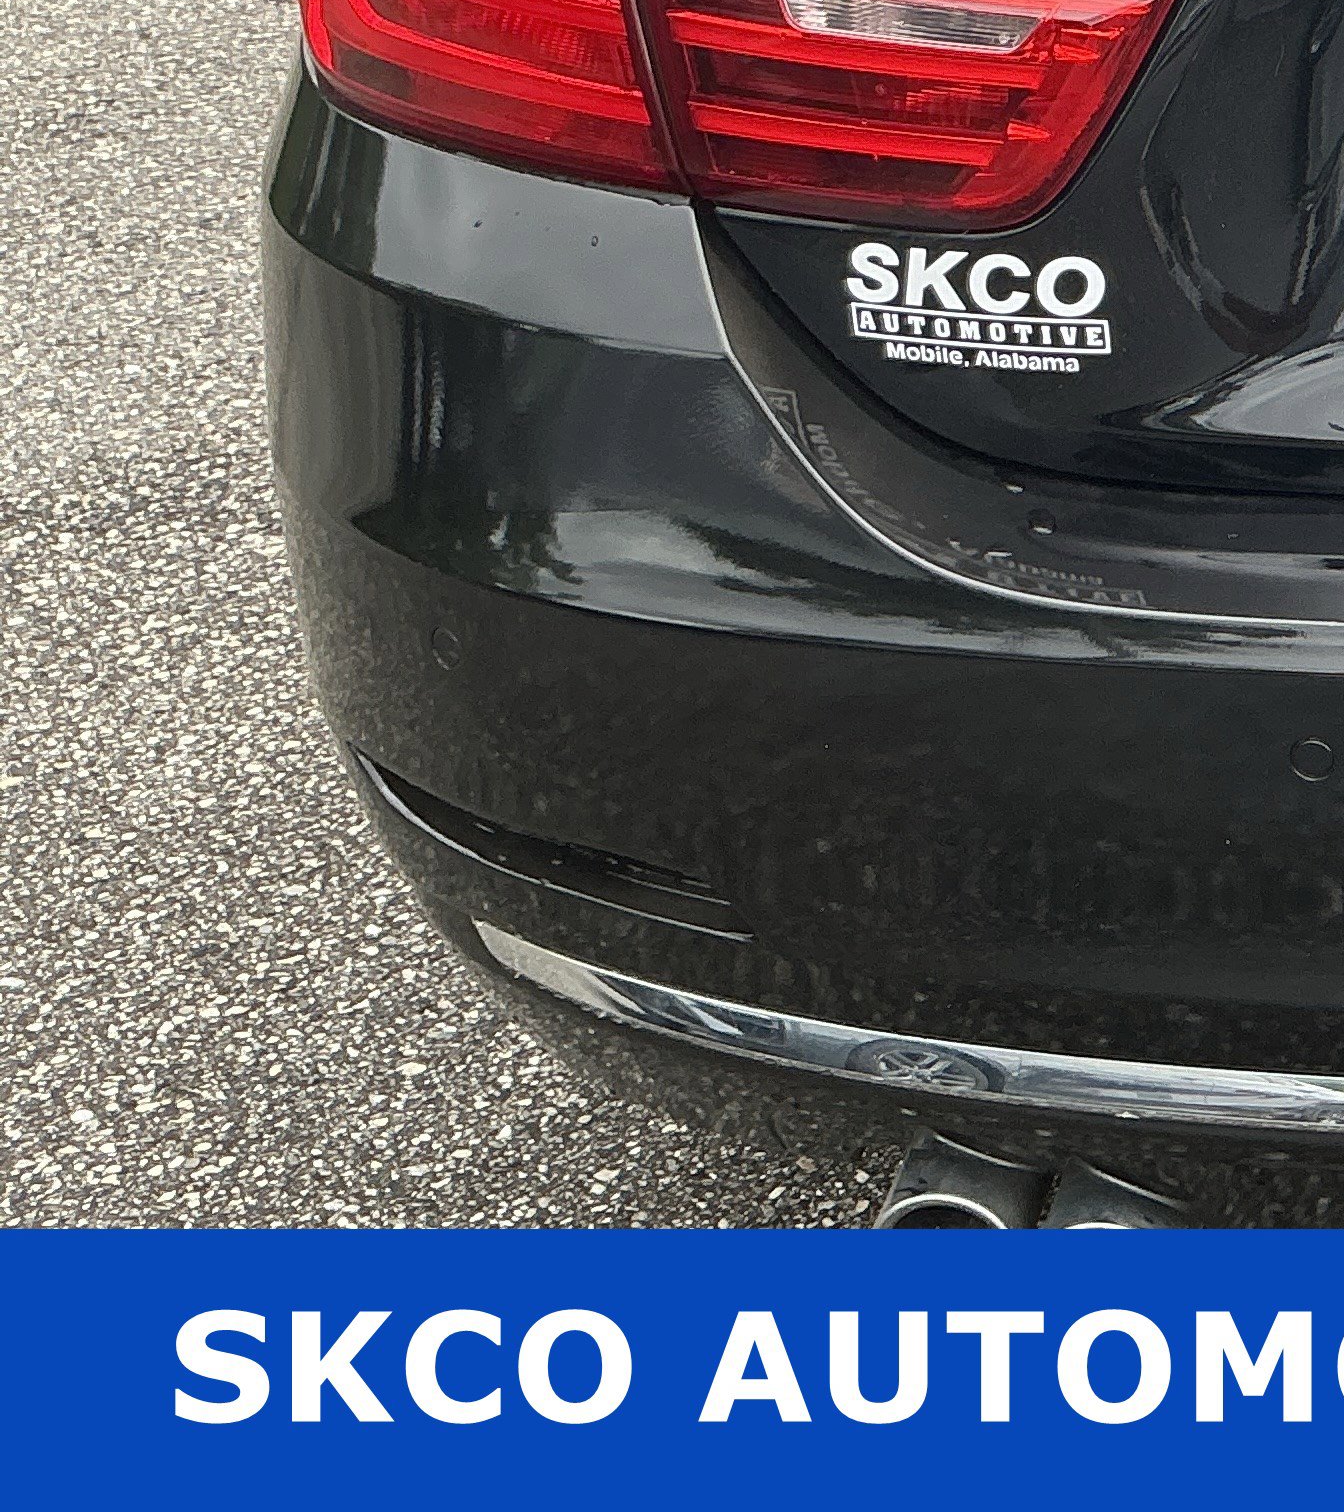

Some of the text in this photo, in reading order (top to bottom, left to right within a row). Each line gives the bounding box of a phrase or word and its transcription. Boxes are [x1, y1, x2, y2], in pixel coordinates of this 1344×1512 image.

[847, 242, 1106, 317] SKCO
[859, 310, 1105, 346] AUTOMOTIVE
[885, 341, 1081, 373] Mobile, Alabama
